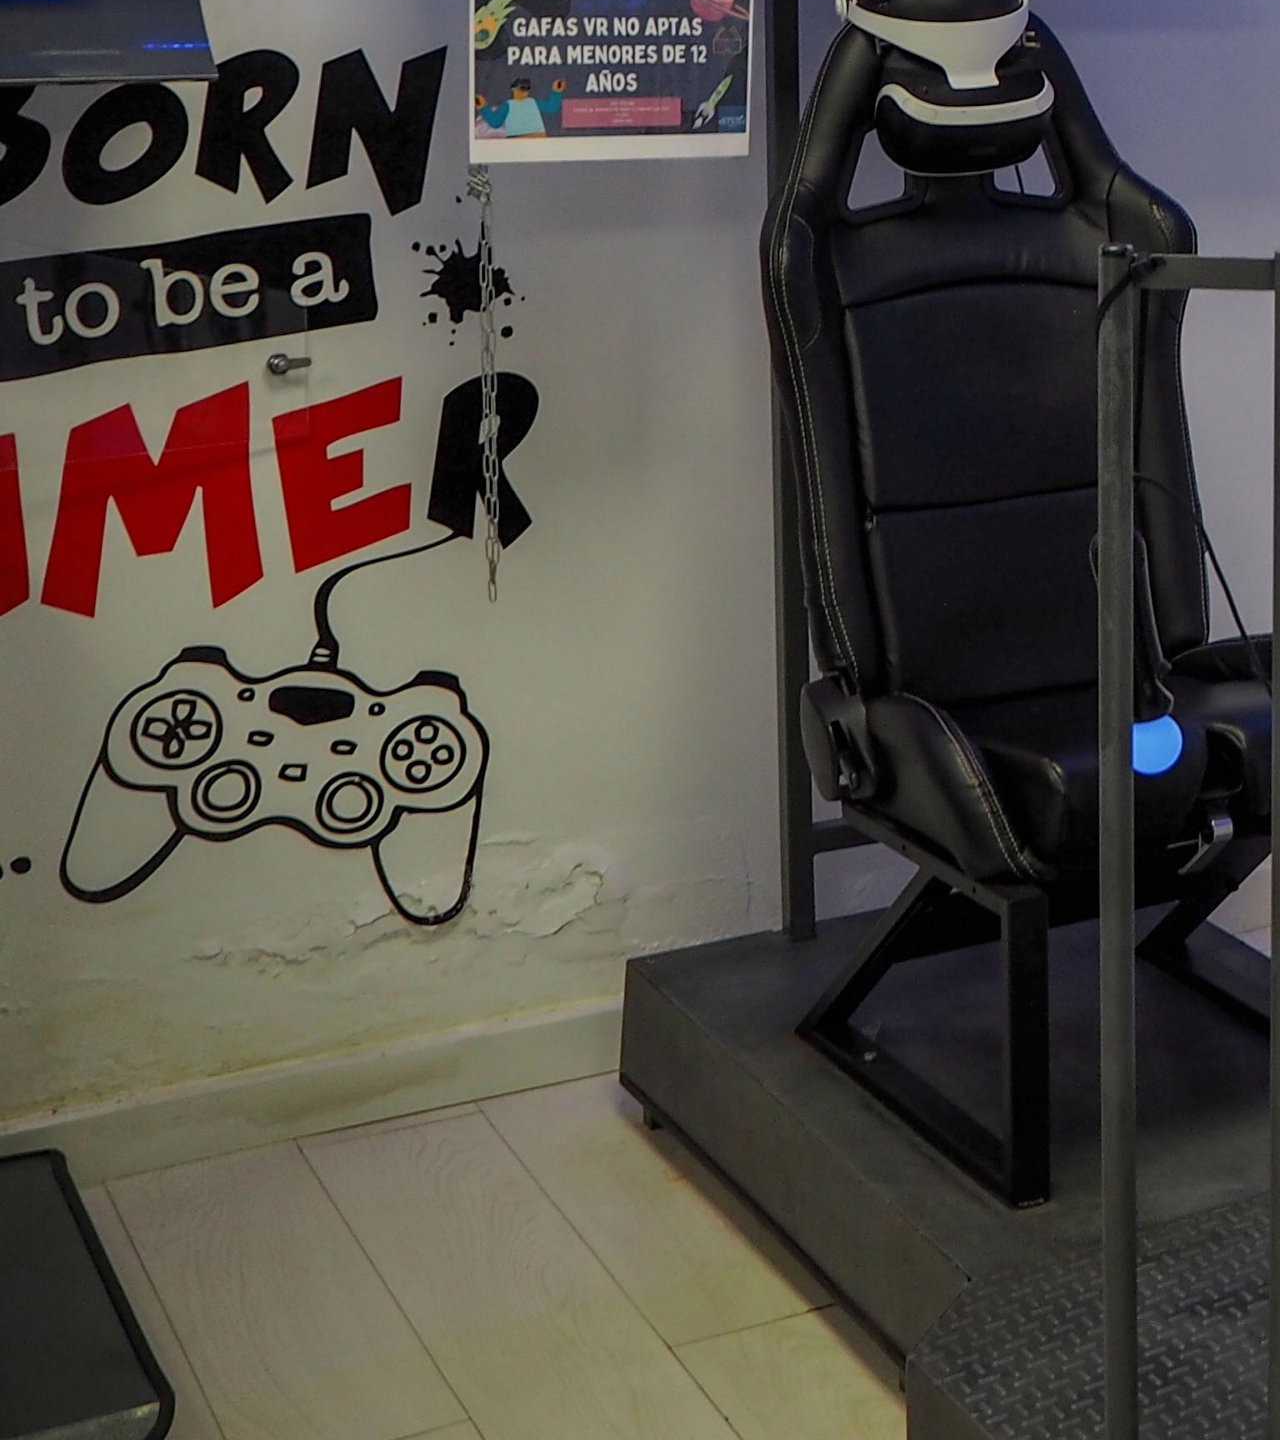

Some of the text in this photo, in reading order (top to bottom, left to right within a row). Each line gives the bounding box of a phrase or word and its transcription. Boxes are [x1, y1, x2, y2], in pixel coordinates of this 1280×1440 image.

[513, 16, 702, 37] GAFAS VR NO APTAS
[507, 44, 707, 65] PARA MENORES DE 12
[586, 69, 638, 93] AÑOS
[15, 251, 349, 346] to be a
[0, 371, 540, 620] MER
